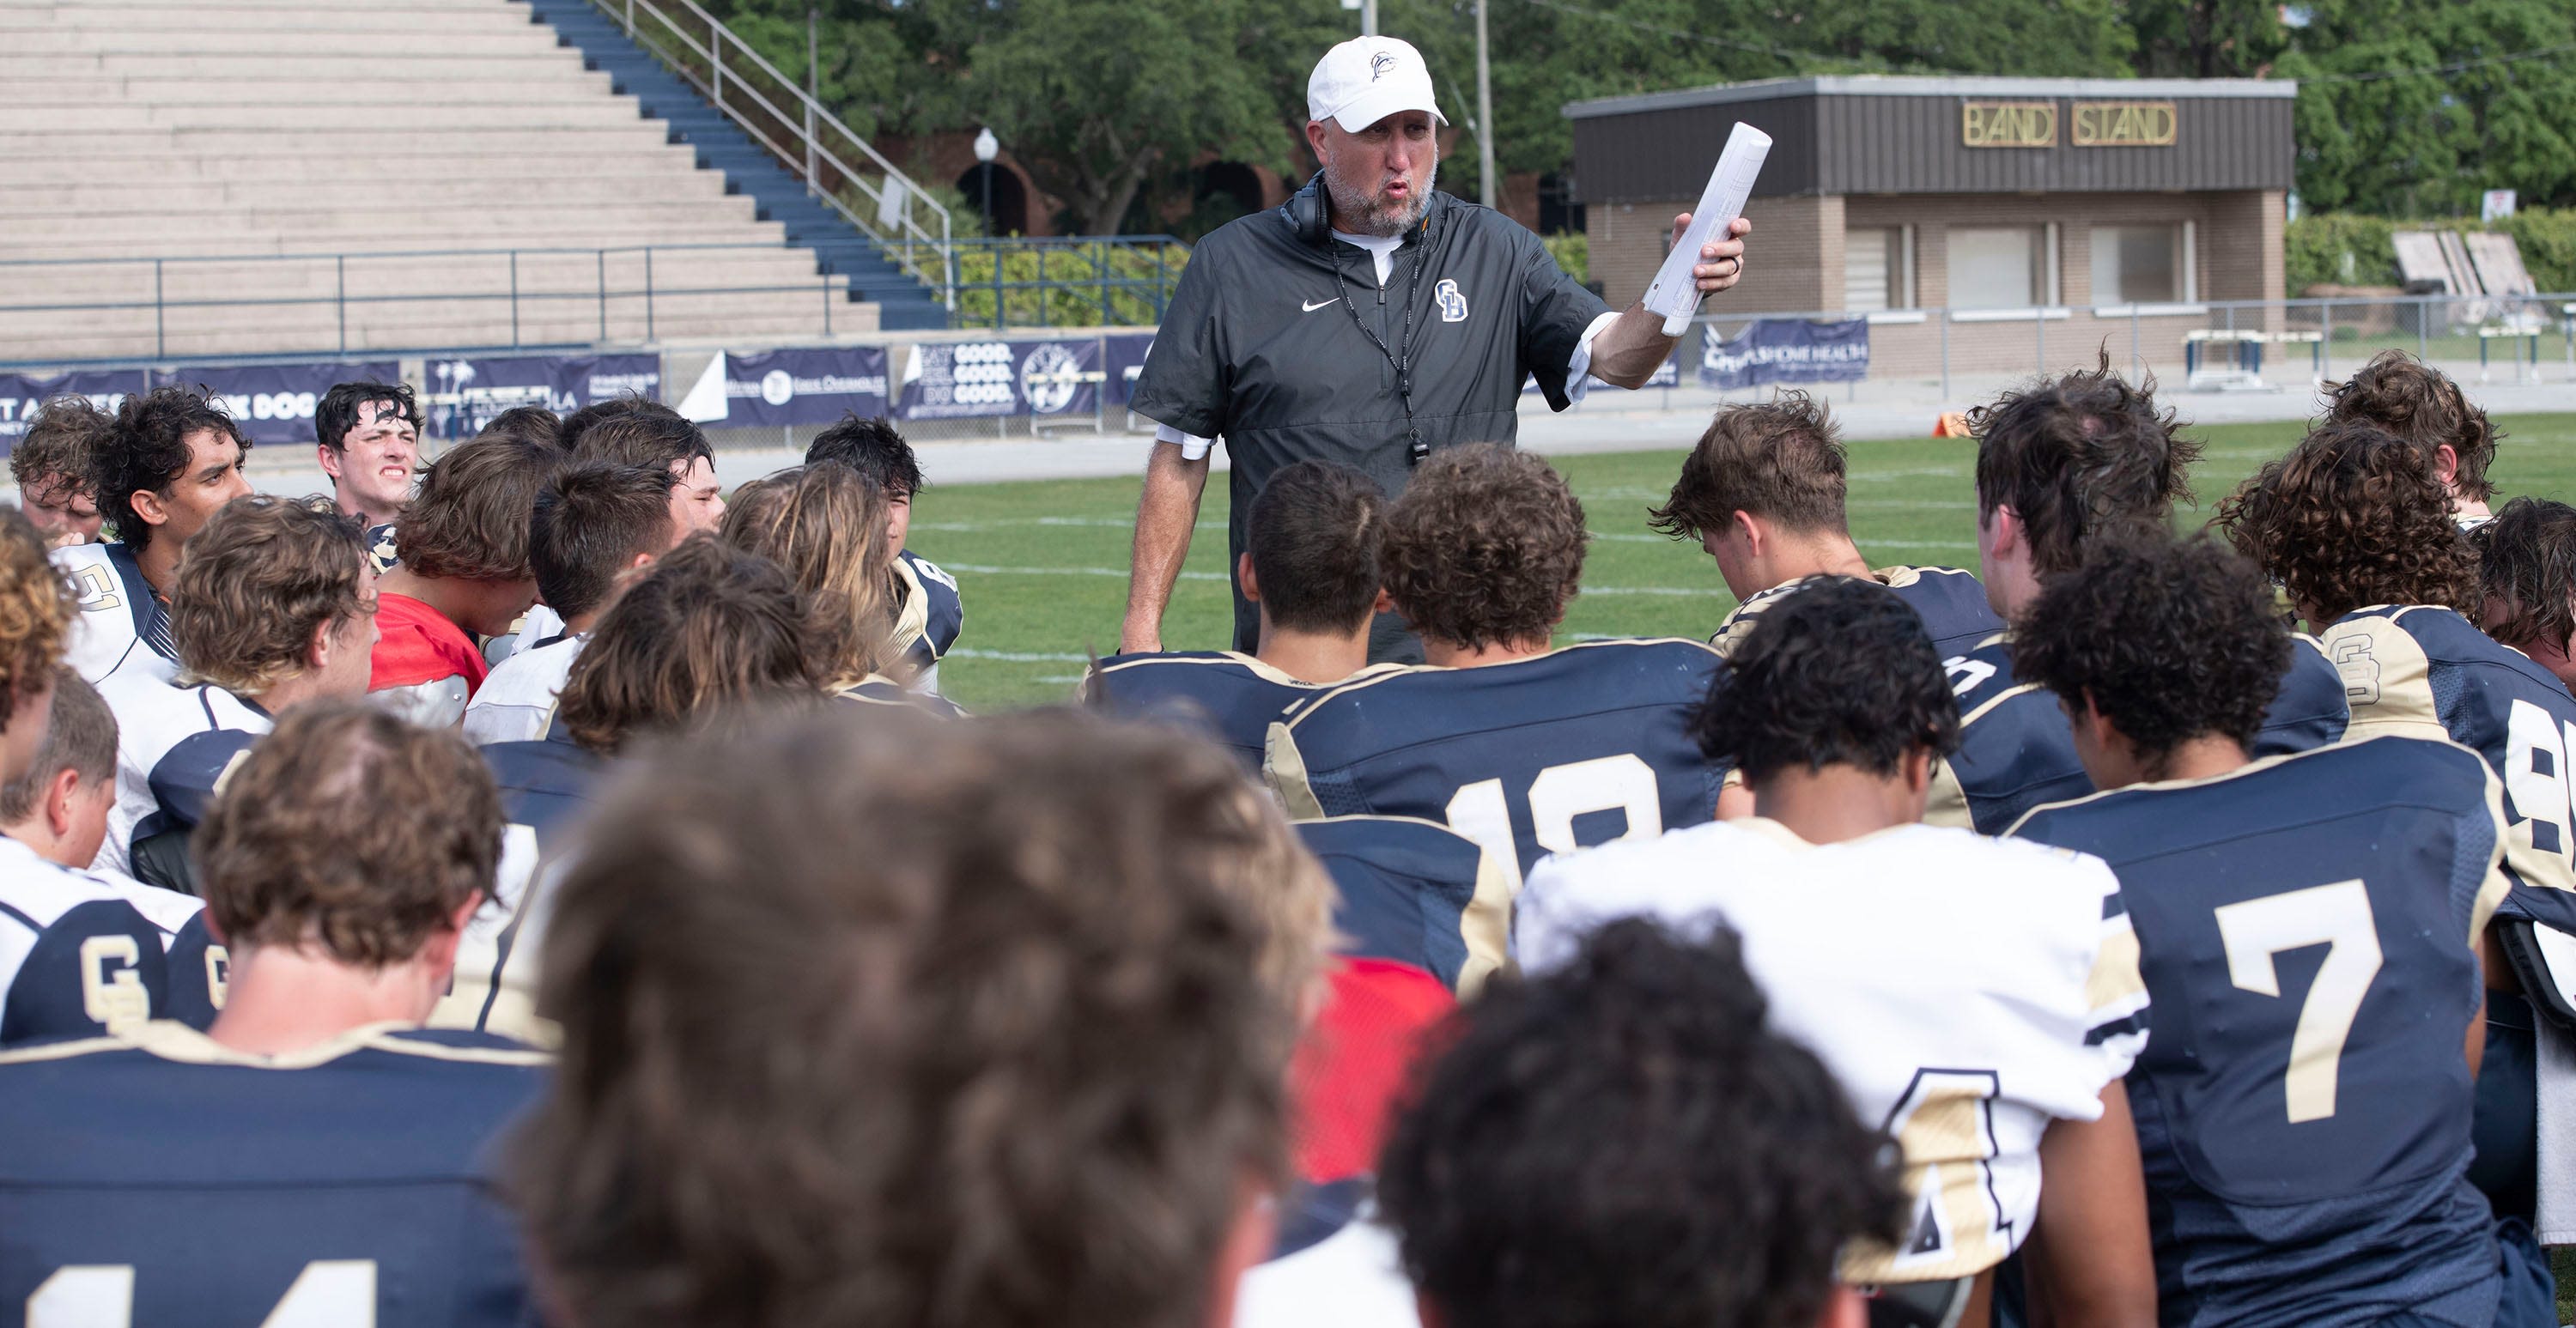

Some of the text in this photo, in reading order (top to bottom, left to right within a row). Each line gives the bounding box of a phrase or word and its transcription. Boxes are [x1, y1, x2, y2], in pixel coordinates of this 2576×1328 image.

[1966, 105, 2176, 145] BAND STAND
[955, 343, 1015, 364] GOOD.
[954, 364, 1015, 384] GOOD.
[924, 384, 1015, 404] DO GOOD.
[2505, 699, 2576, 895] 9
[2215, 878, 2384, 1124] 7
